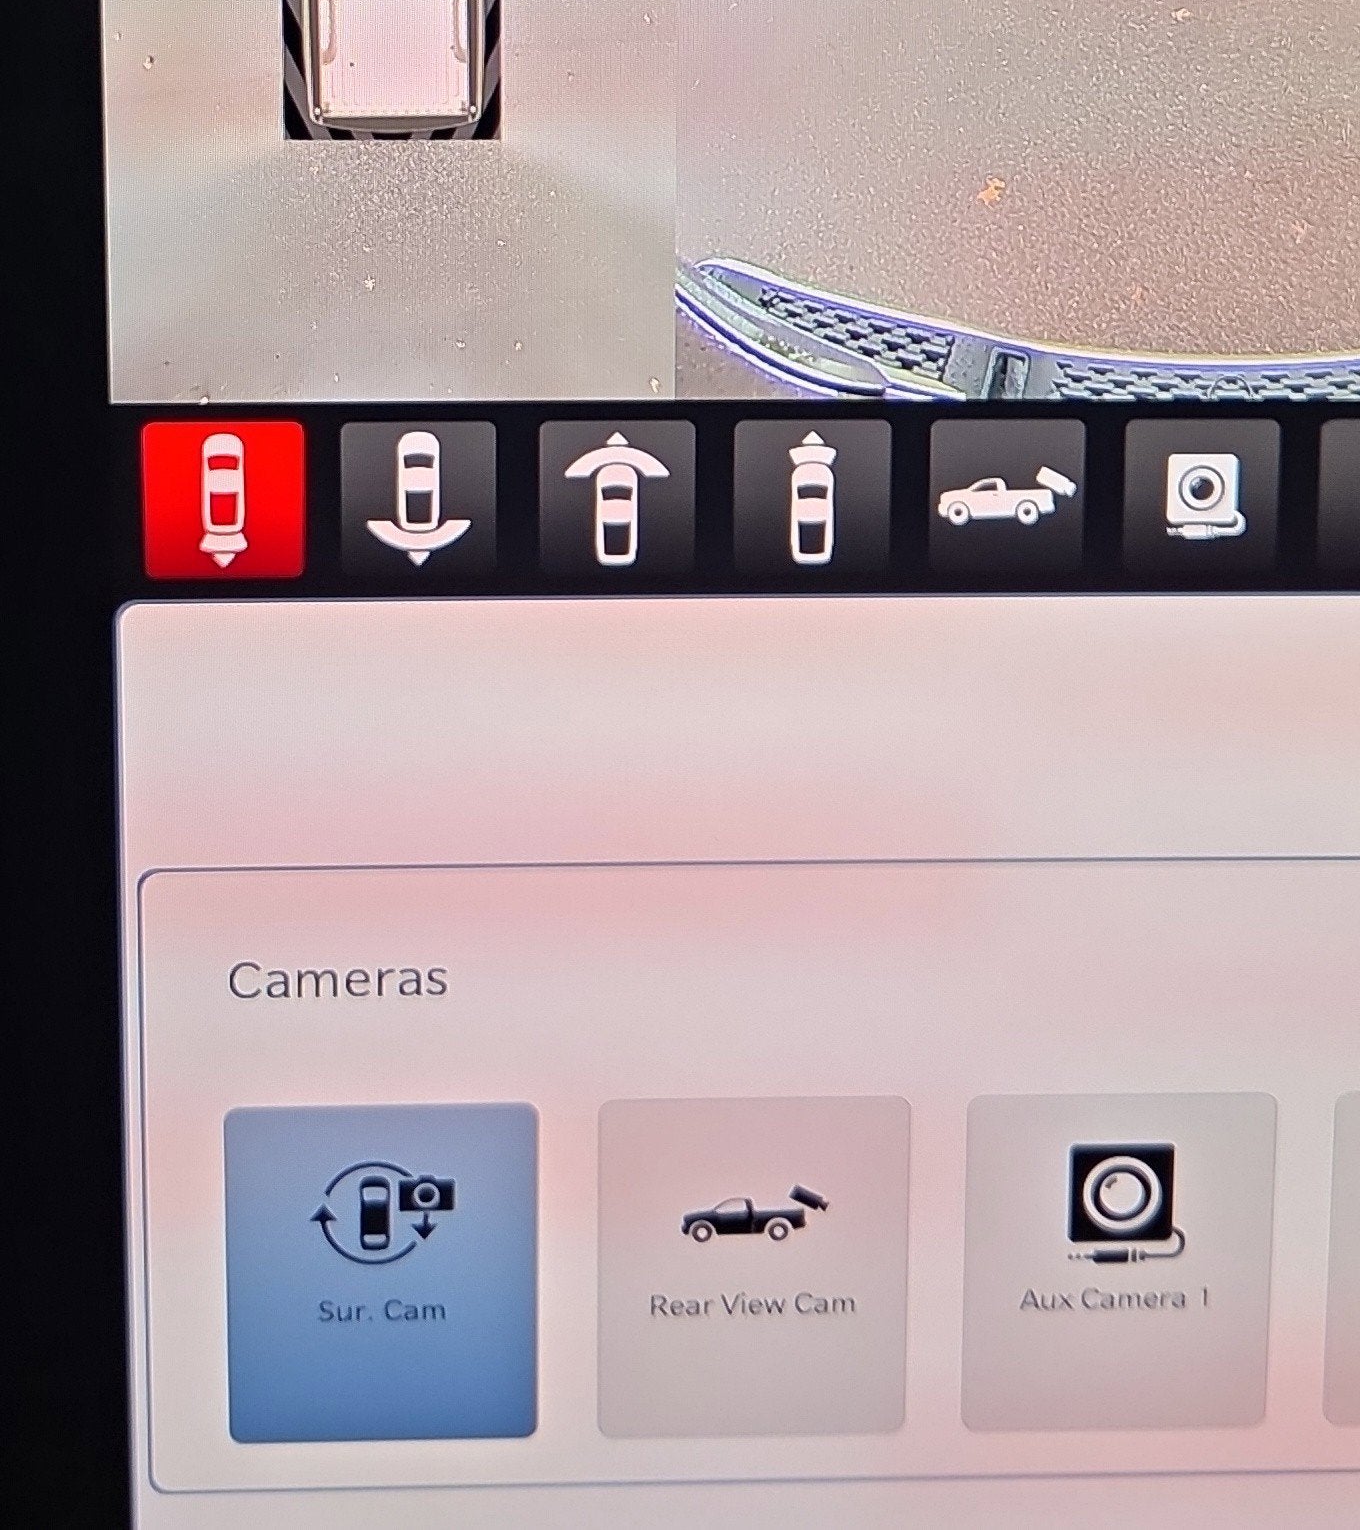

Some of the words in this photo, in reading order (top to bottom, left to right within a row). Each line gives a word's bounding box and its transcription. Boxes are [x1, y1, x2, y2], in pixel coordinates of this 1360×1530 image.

[229, 961, 448, 999] Cameras
[317, 1299, 373, 1323] Sur.
[383, 1298, 446, 1322] Cam
[650, 1293, 714, 1318] Rear
[720, 1291, 787, 1316] View
[794, 1292, 856, 1316] Cam
[1019, 1288, 1074, 1312] Aux
[1080, 1287, 1186, 1311] Camera
[1201, 1286, 1210, 1307] 1
